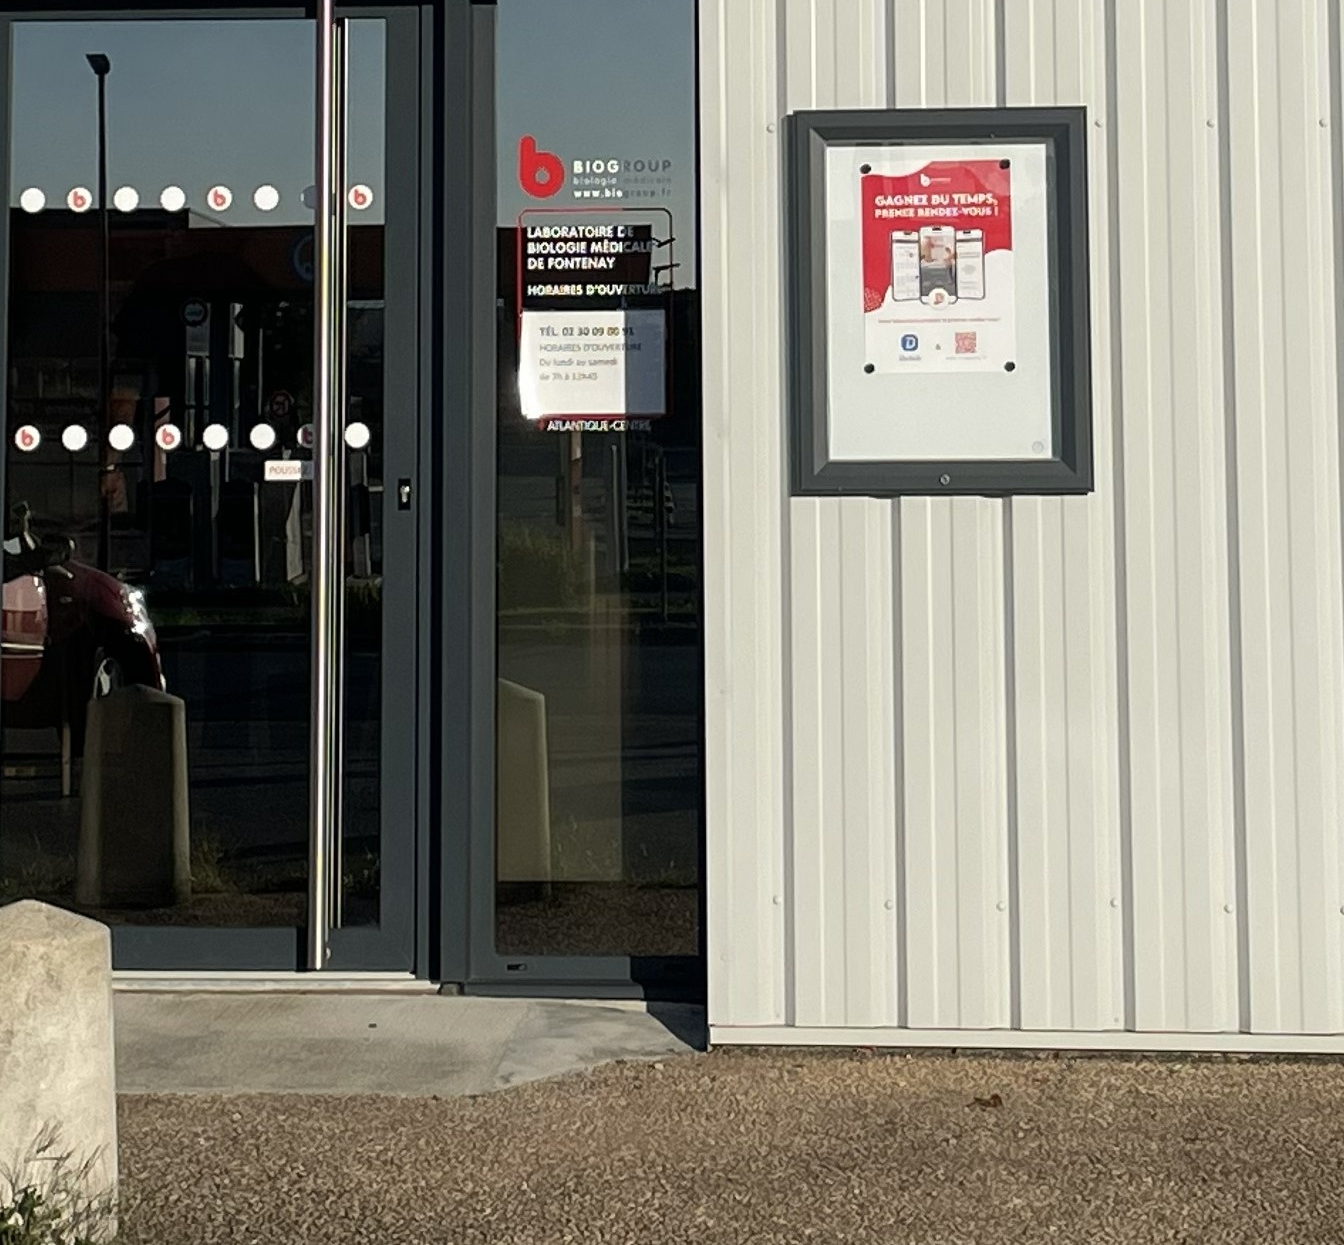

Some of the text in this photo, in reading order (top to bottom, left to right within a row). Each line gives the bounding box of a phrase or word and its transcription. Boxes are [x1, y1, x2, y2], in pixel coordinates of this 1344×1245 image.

[573, 159, 672, 174] BIOGROUP
[573, 176, 617, 187] biologie
[875, 195, 928, 206] GAGNEZ
[931, 194, 950, 205] DU
[875, 208, 915, 218] PRENEZ
[917, 207, 992, 217] RENDEZ-VOUS
[527, 225, 634, 238] LABORATOIRE DE
[527, 242, 587, 254] BIOLOGIE
[527, 257, 616, 270] DE FONTENAY
[527, 284, 583, 296] HORAIRES
